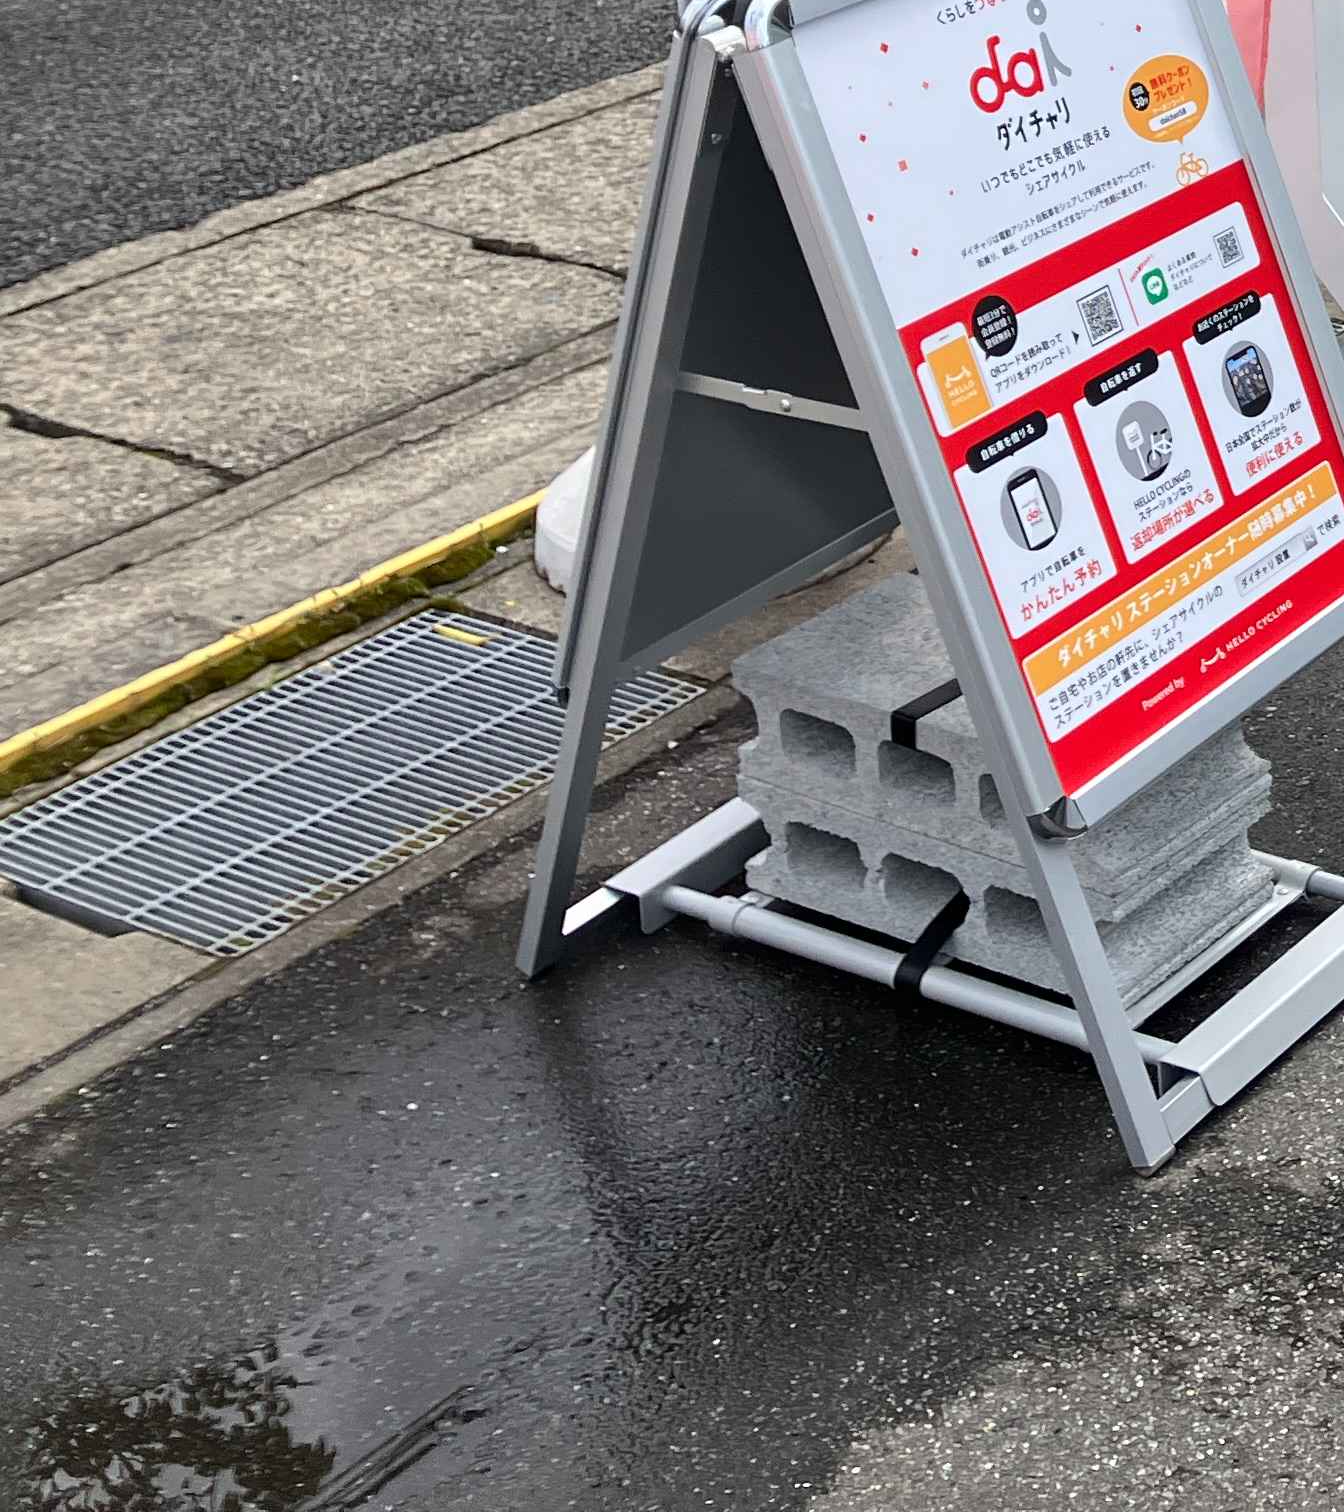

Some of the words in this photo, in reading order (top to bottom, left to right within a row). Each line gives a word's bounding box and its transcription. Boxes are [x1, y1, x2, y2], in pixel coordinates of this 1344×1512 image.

[996, 96, 1071, 151] ダイチャリ
[981, 125, 1112, 193] いつでもどこでも気軽に使える
[1024, 159, 1087, 197] シェアサイクル
[990, 333, 1063, 378] QRコードを読み取って
[1099, 361, 1143, 394] 自転車を返す
[1246, 431, 1304, 478] 便利に使える
[1130, 488, 1216, 552] 返却場所が選べる
[1138, 481, 1194, 523] ステーションなら
[1020, 545, 1087, 593] アプリで自転車を
[1020, 558, 1103, 622] かんたん予約
[1057, 610, 1124, 669] ダイチャリ
[1225, 626, 1256, 653] HELLO
[1255, 599, 1294, 630] CYCLING
[1141, 681, 1175, 712] Powered
[1172, 675, 1186, 691] by
